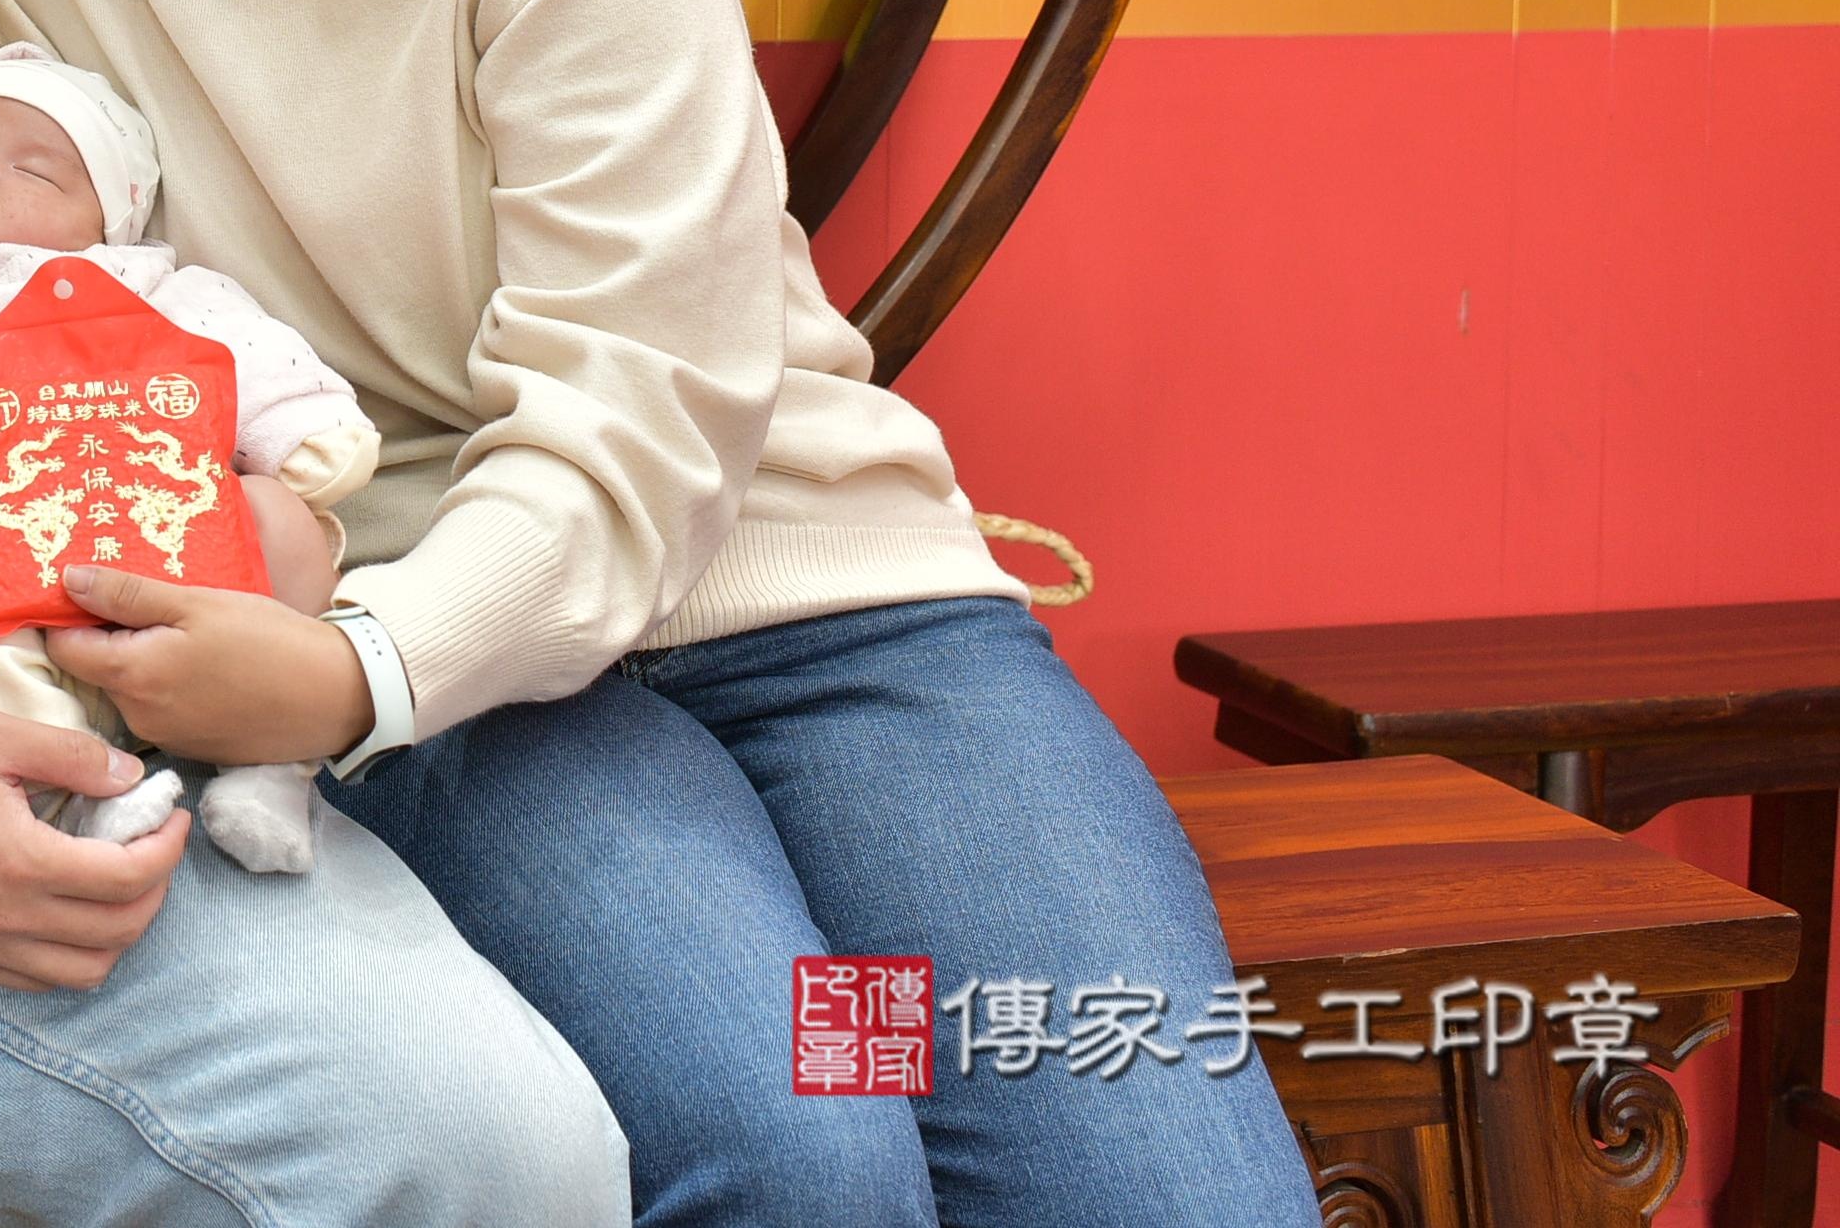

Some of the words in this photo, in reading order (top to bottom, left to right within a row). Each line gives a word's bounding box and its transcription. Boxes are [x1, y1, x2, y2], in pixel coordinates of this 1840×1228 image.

[27, 399, 146, 425] 特選珍珠米
[147, 376, 198, 417] 福
[76, 433, 124, 562] 永保安康
